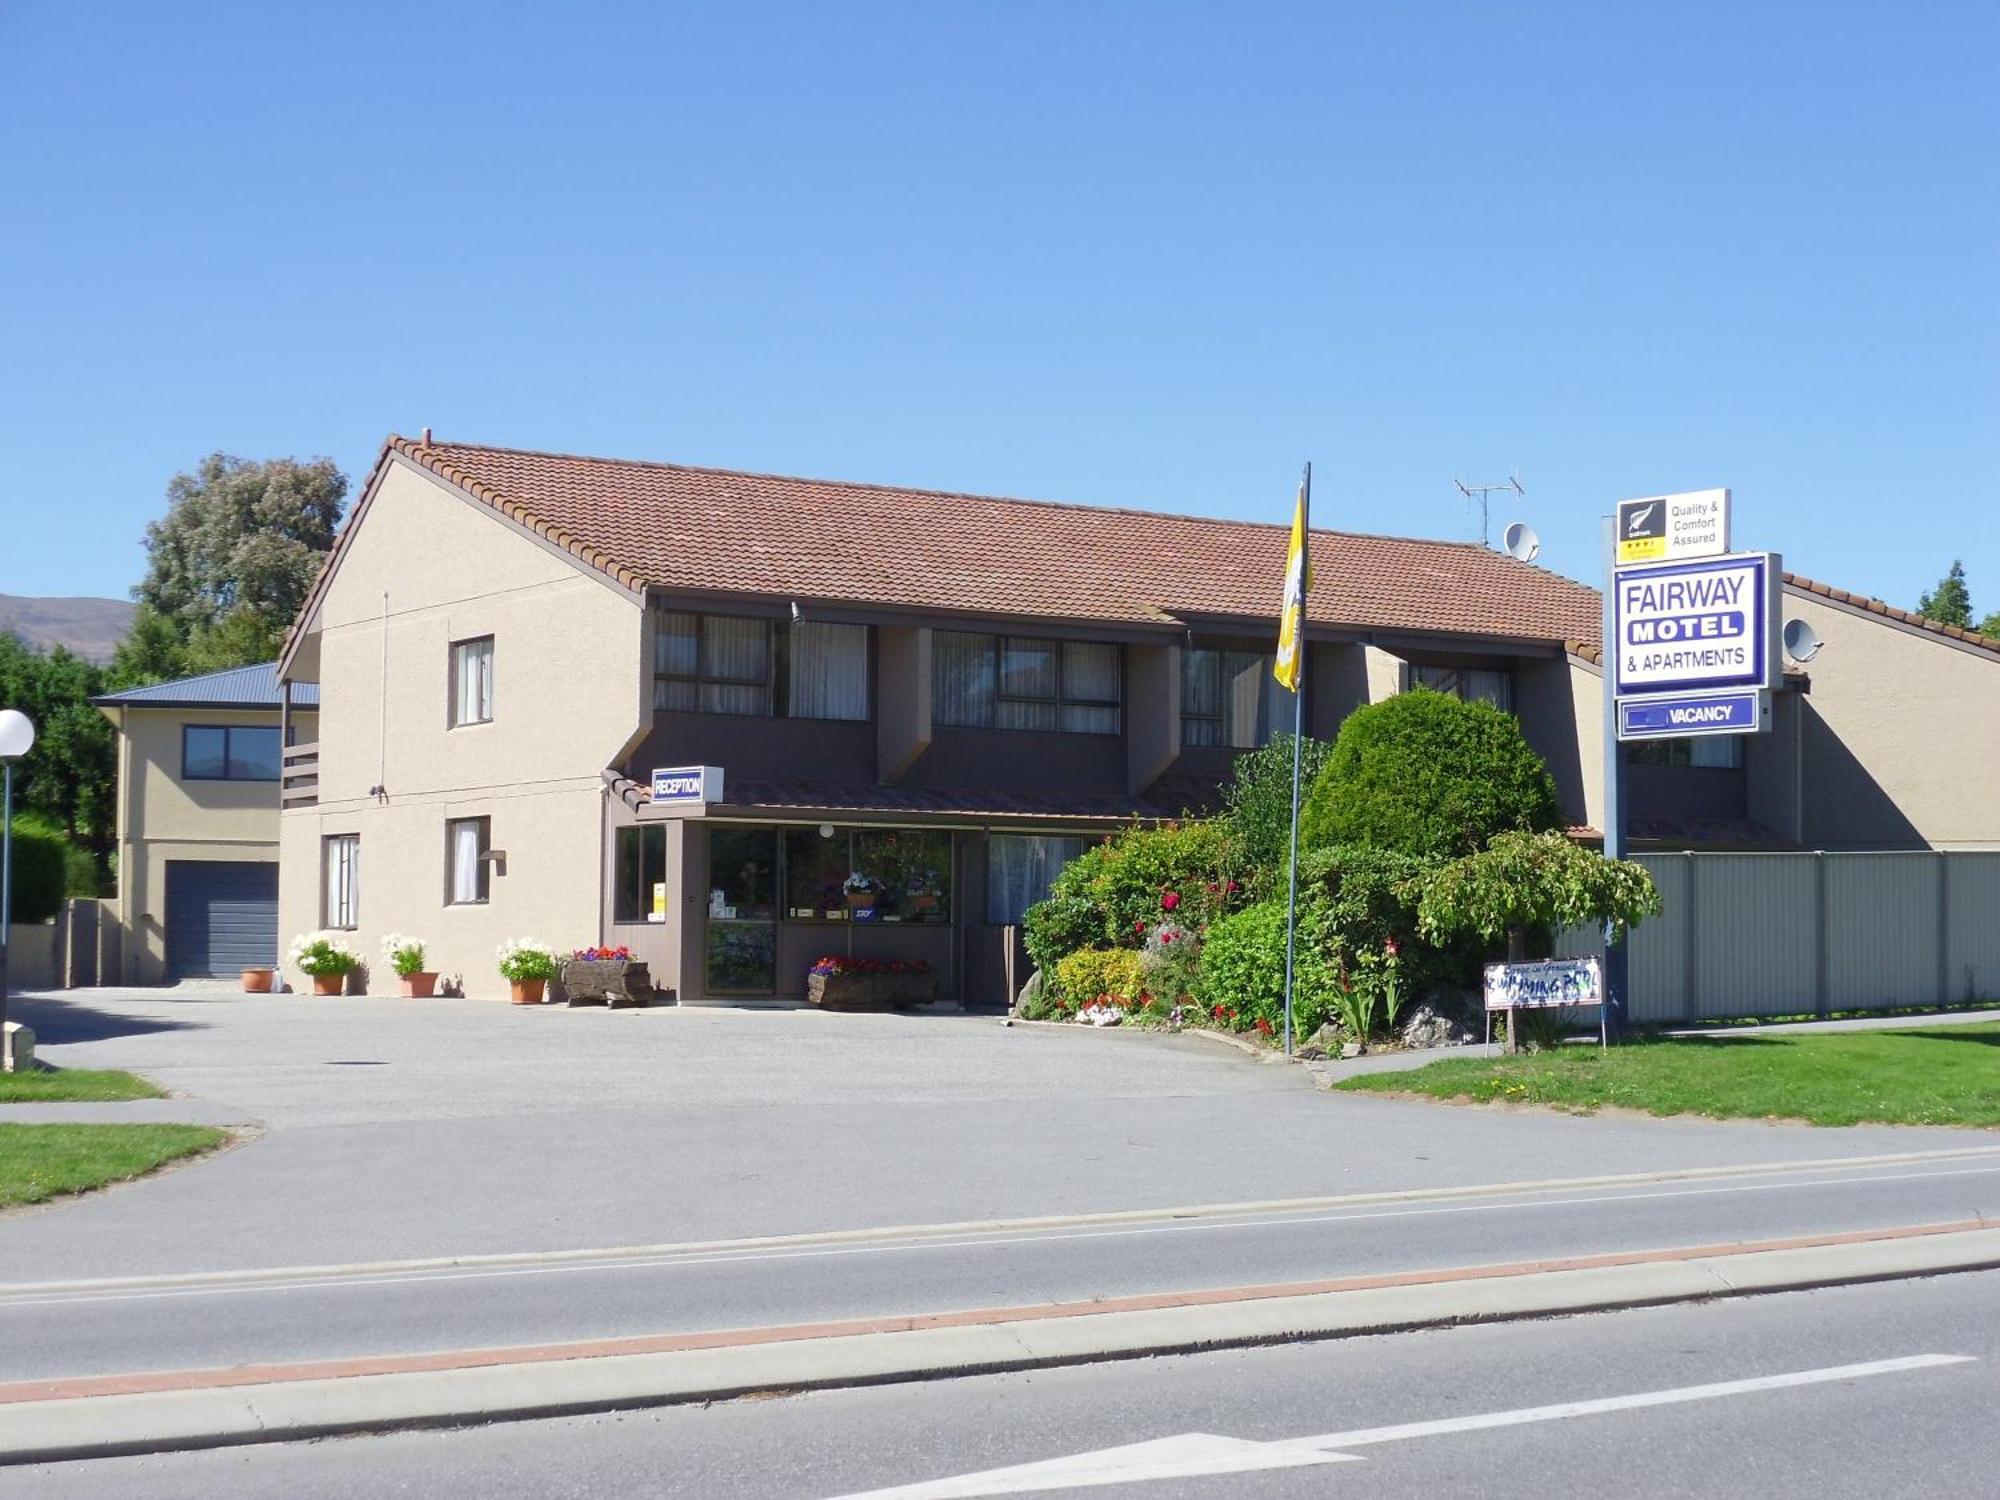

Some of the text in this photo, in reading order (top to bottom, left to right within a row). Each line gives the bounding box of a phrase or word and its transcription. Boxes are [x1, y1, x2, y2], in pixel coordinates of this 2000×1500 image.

[1671, 501, 1718, 517] Quality &
[1674, 518, 1716, 532] Comfort
[1673, 532, 1716, 546] Assured
[1627, 576, 1745, 614] FAIRWAY
[1632, 616, 1738, 643] MOTEL
[1627, 647, 1745, 672] & APARTMENTS
[1670, 705, 1733, 724] VACANCY
[656, 778, 700, 794] RECEPTION
